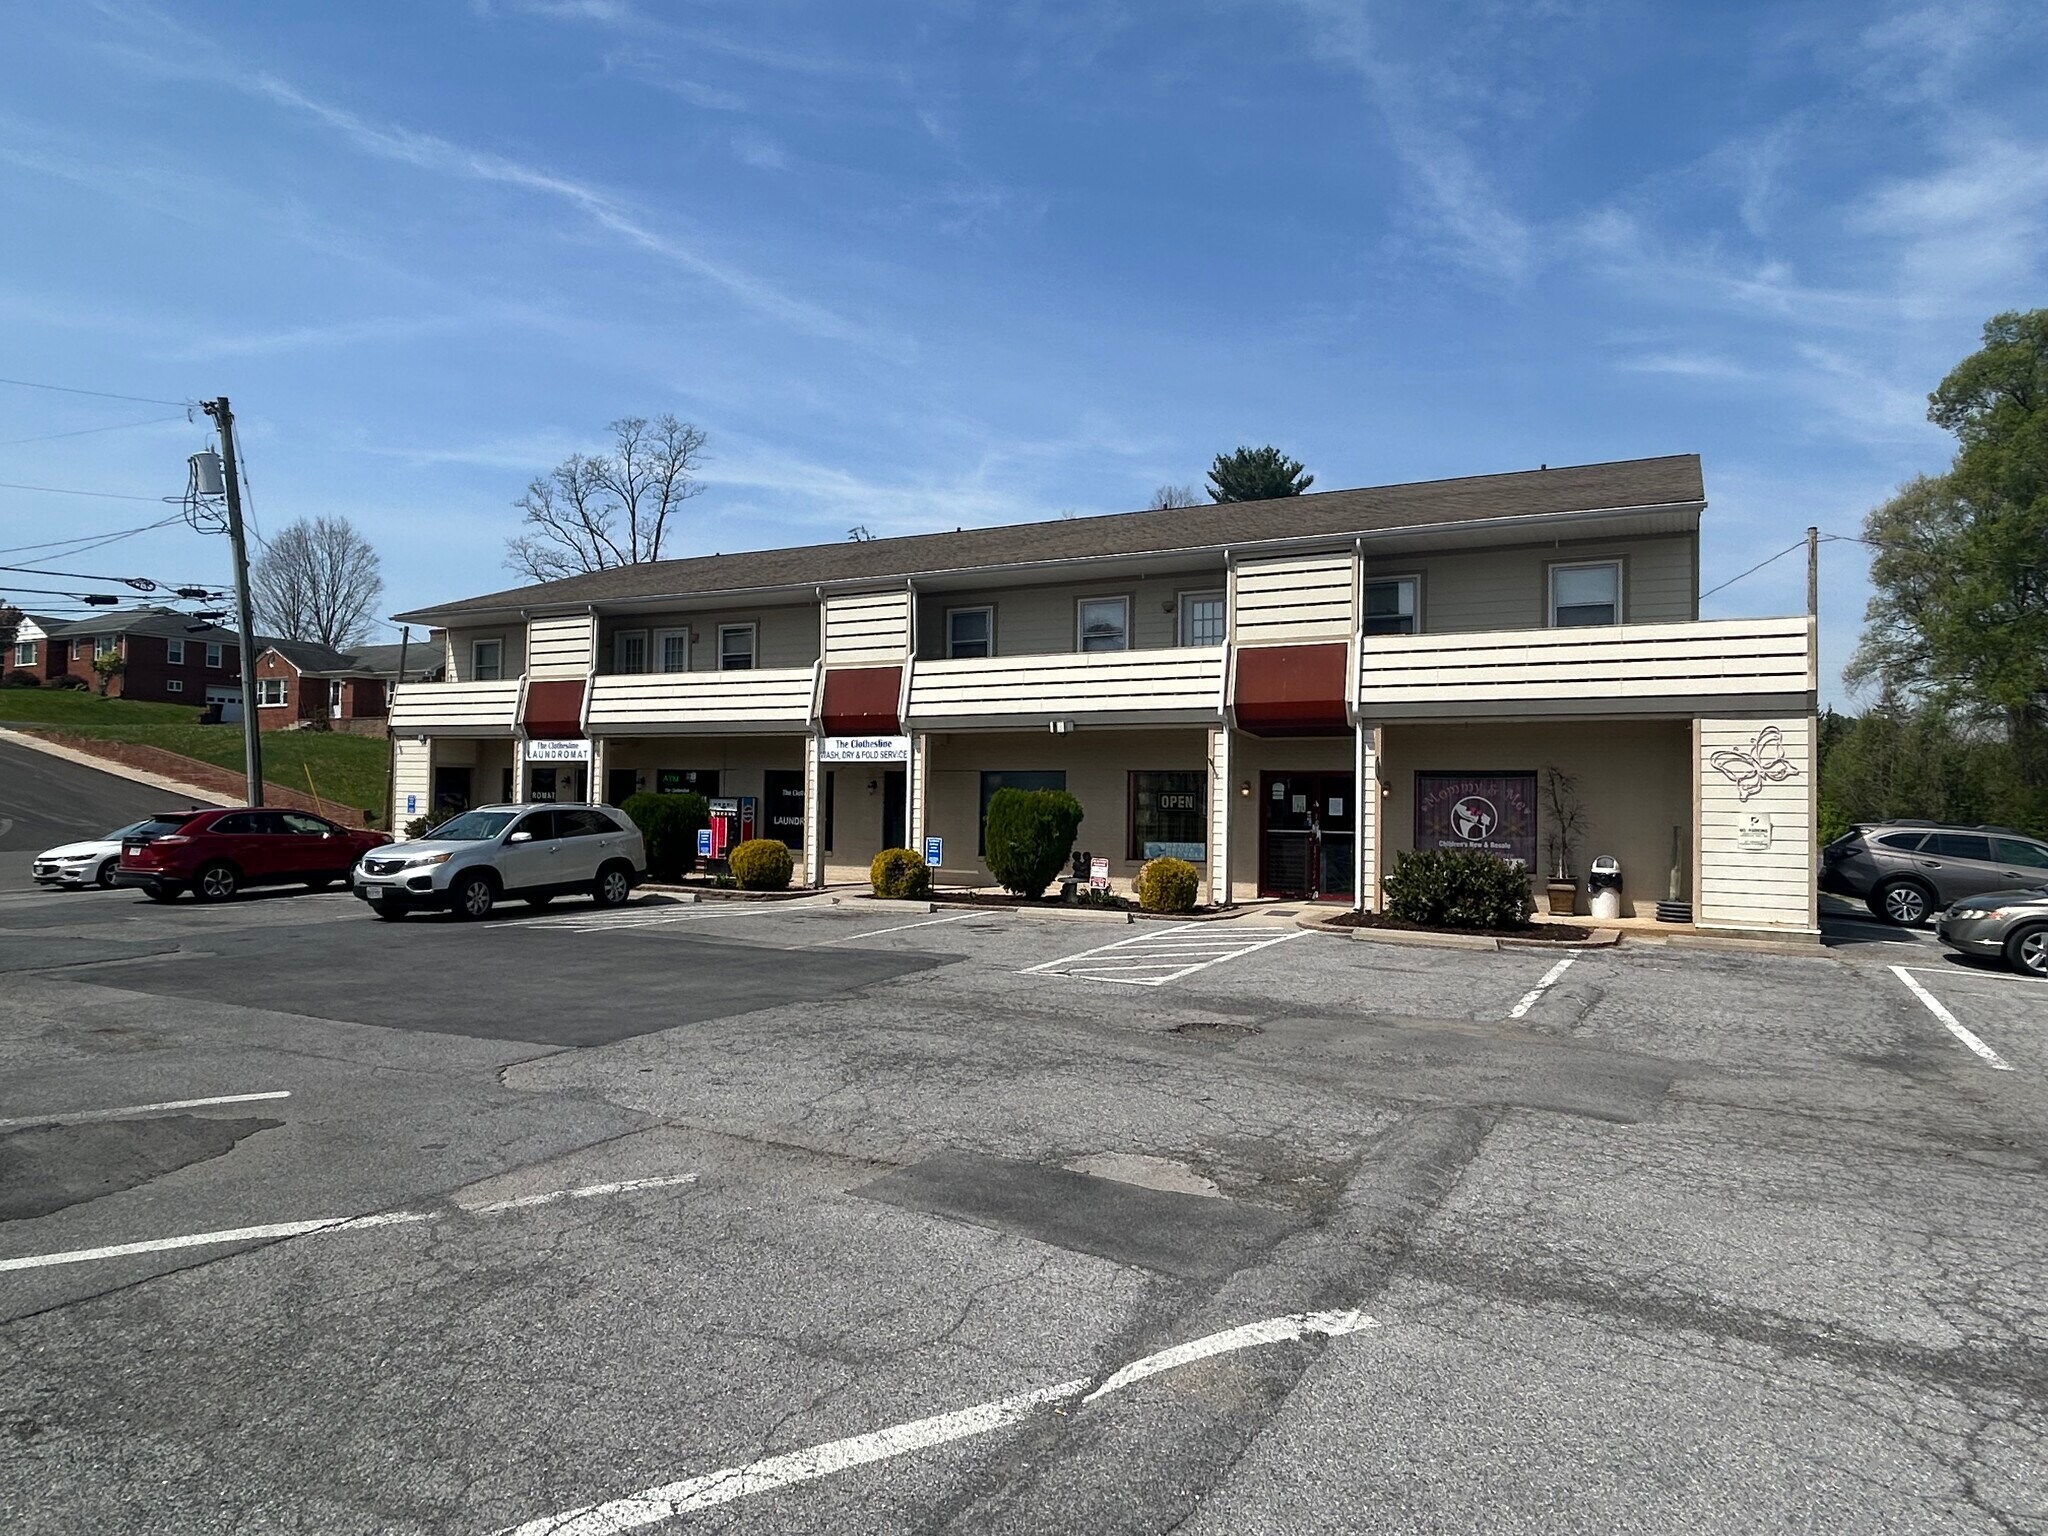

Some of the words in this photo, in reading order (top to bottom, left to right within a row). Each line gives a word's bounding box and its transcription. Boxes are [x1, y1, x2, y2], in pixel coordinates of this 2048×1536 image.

[836, 740, 848, 749] The
[851, 740, 892, 749] Clothesline
[842, 751, 855, 759] DRY
[855, 751, 861, 759] &
[861, 751, 879, 759] FOLD
[880, 750, 908, 759] SERVICE
[1161, 795, 1194, 809] OPEN
